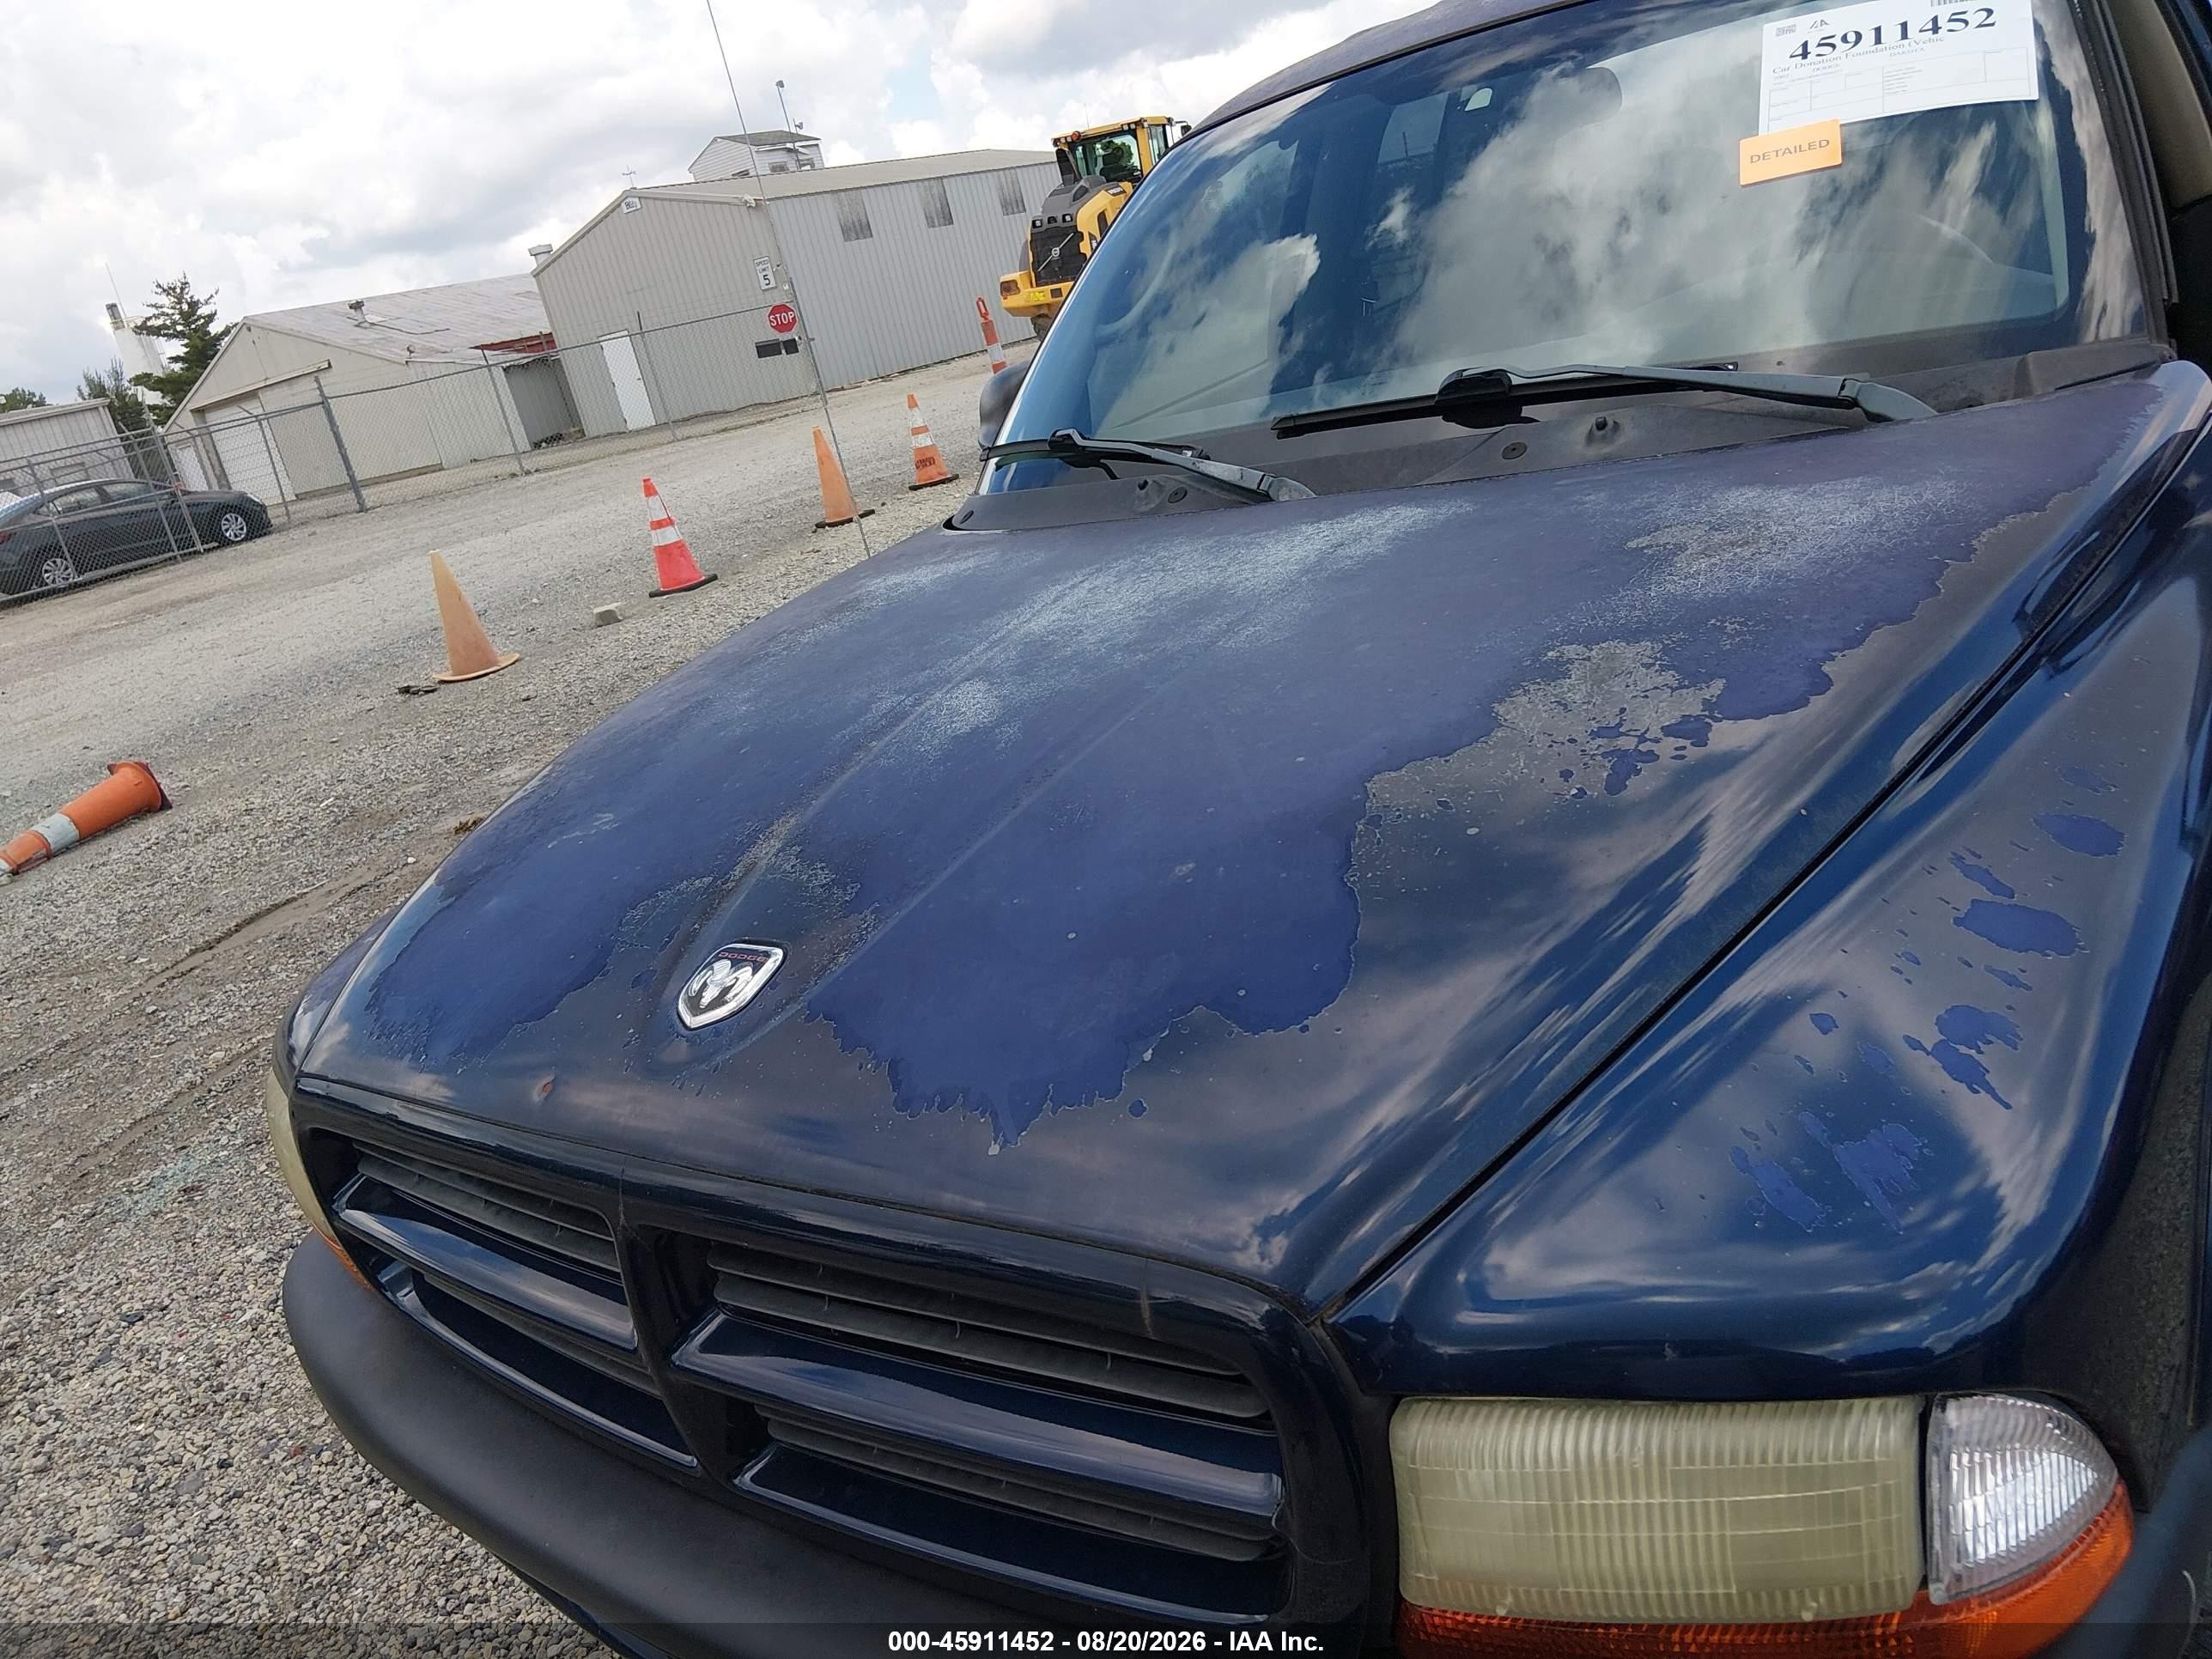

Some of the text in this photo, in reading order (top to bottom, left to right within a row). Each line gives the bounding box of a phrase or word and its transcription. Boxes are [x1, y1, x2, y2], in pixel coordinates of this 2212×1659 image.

[1789, 7, 1997, 60] 45911452
[1772, 66, 1790, 75] Car
[1795, 56, 1842, 70] Donation
[1845, 44, 1905, 59] Foundation
[1750, 139, 1830, 164] DETAILED
[763, 274, 770, 286] 5
[769, 311, 795, 326] STOP
[719, 951, 767, 963] DODGE
